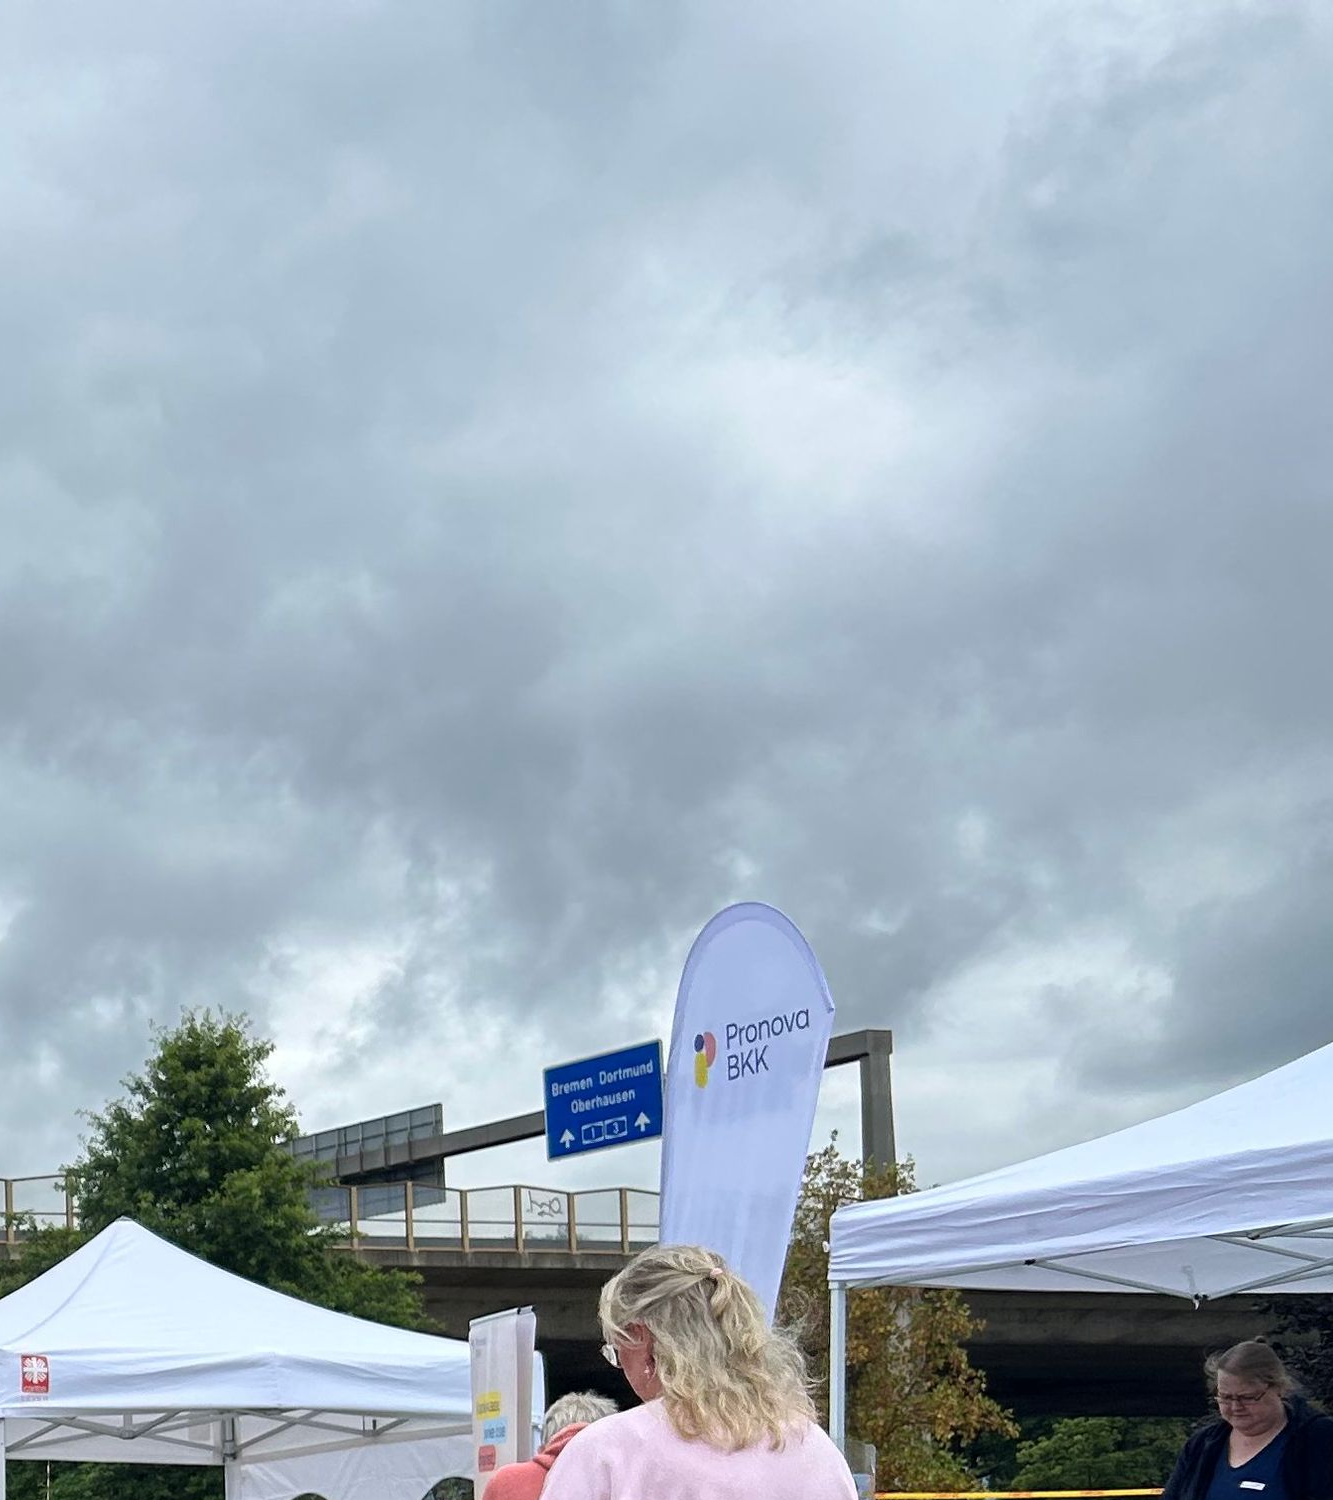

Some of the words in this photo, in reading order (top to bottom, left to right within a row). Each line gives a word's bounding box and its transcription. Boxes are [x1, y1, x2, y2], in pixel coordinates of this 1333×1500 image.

[725, 1008, 810, 1050] Pronova
[551, 1076, 593, 1097] Bremen
[599, 1059, 654, 1084] Dortmund
[727, 1045, 769, 1081] BKK
[570, 1088, 636, 1114] Oberhausen
